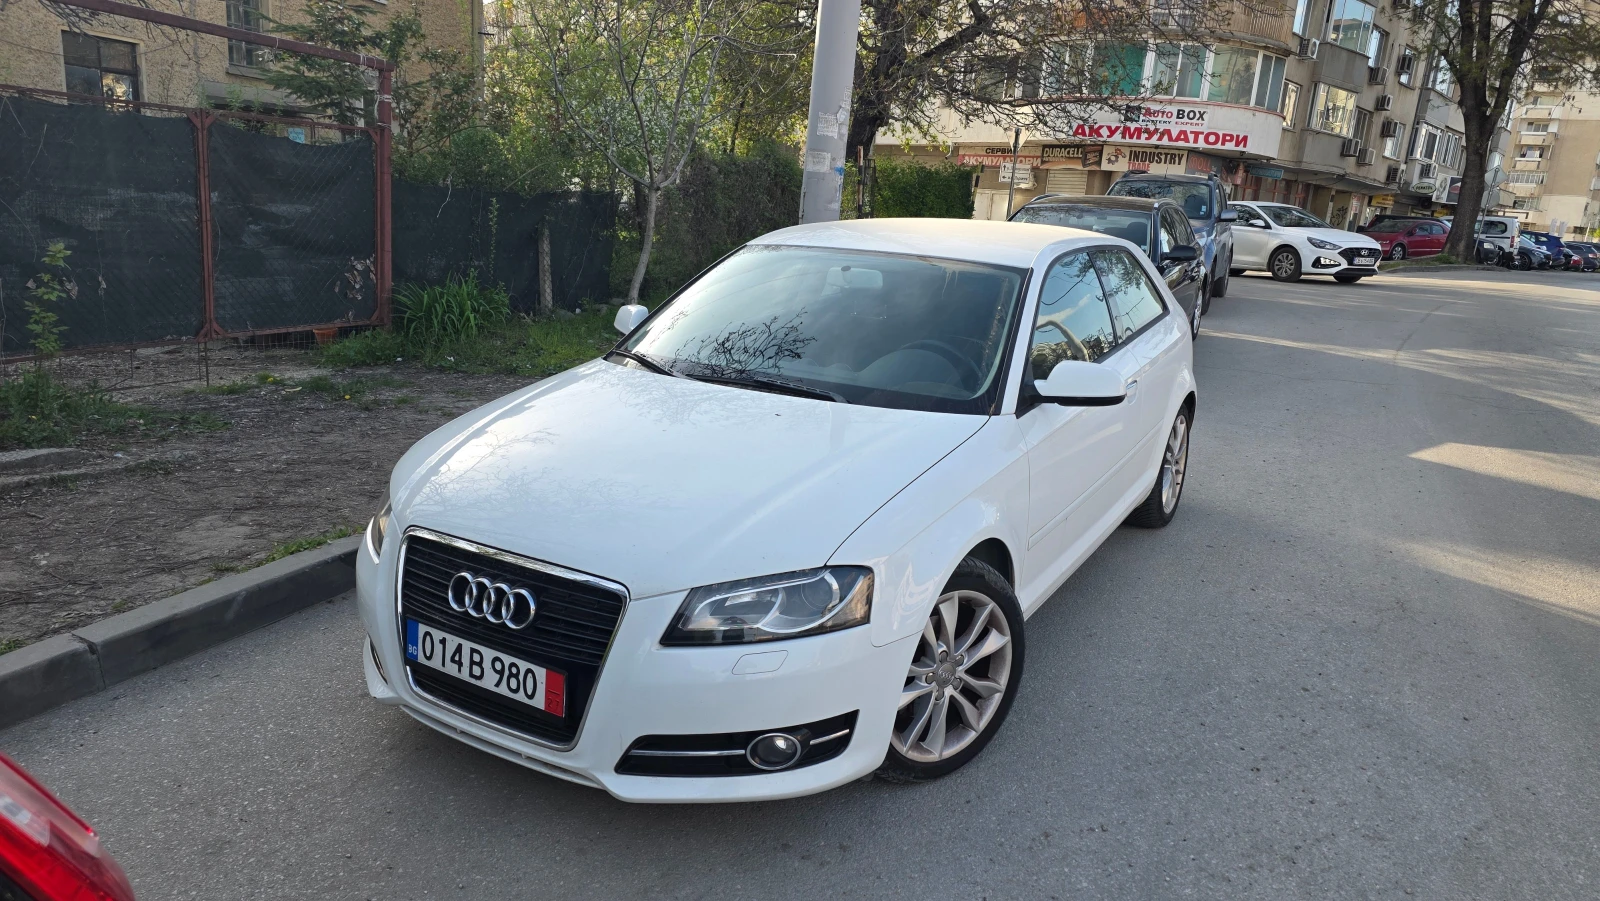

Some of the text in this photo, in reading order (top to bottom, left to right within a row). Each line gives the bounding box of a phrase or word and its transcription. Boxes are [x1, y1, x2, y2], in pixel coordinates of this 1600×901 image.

[1175, 108, 1207, 121] BOX
[1072, 123, 1248, 149] АКУМУЛАТОРИ
[985, 147, 1018, 155] СЕРВИ
[1043, 147, 1083, 158] DURACELL
[1128, 149, 1184, 166] INDUSTRY
[1127, 161, 1151, 172] TRADE
[408, 643, 418, 655] BG
